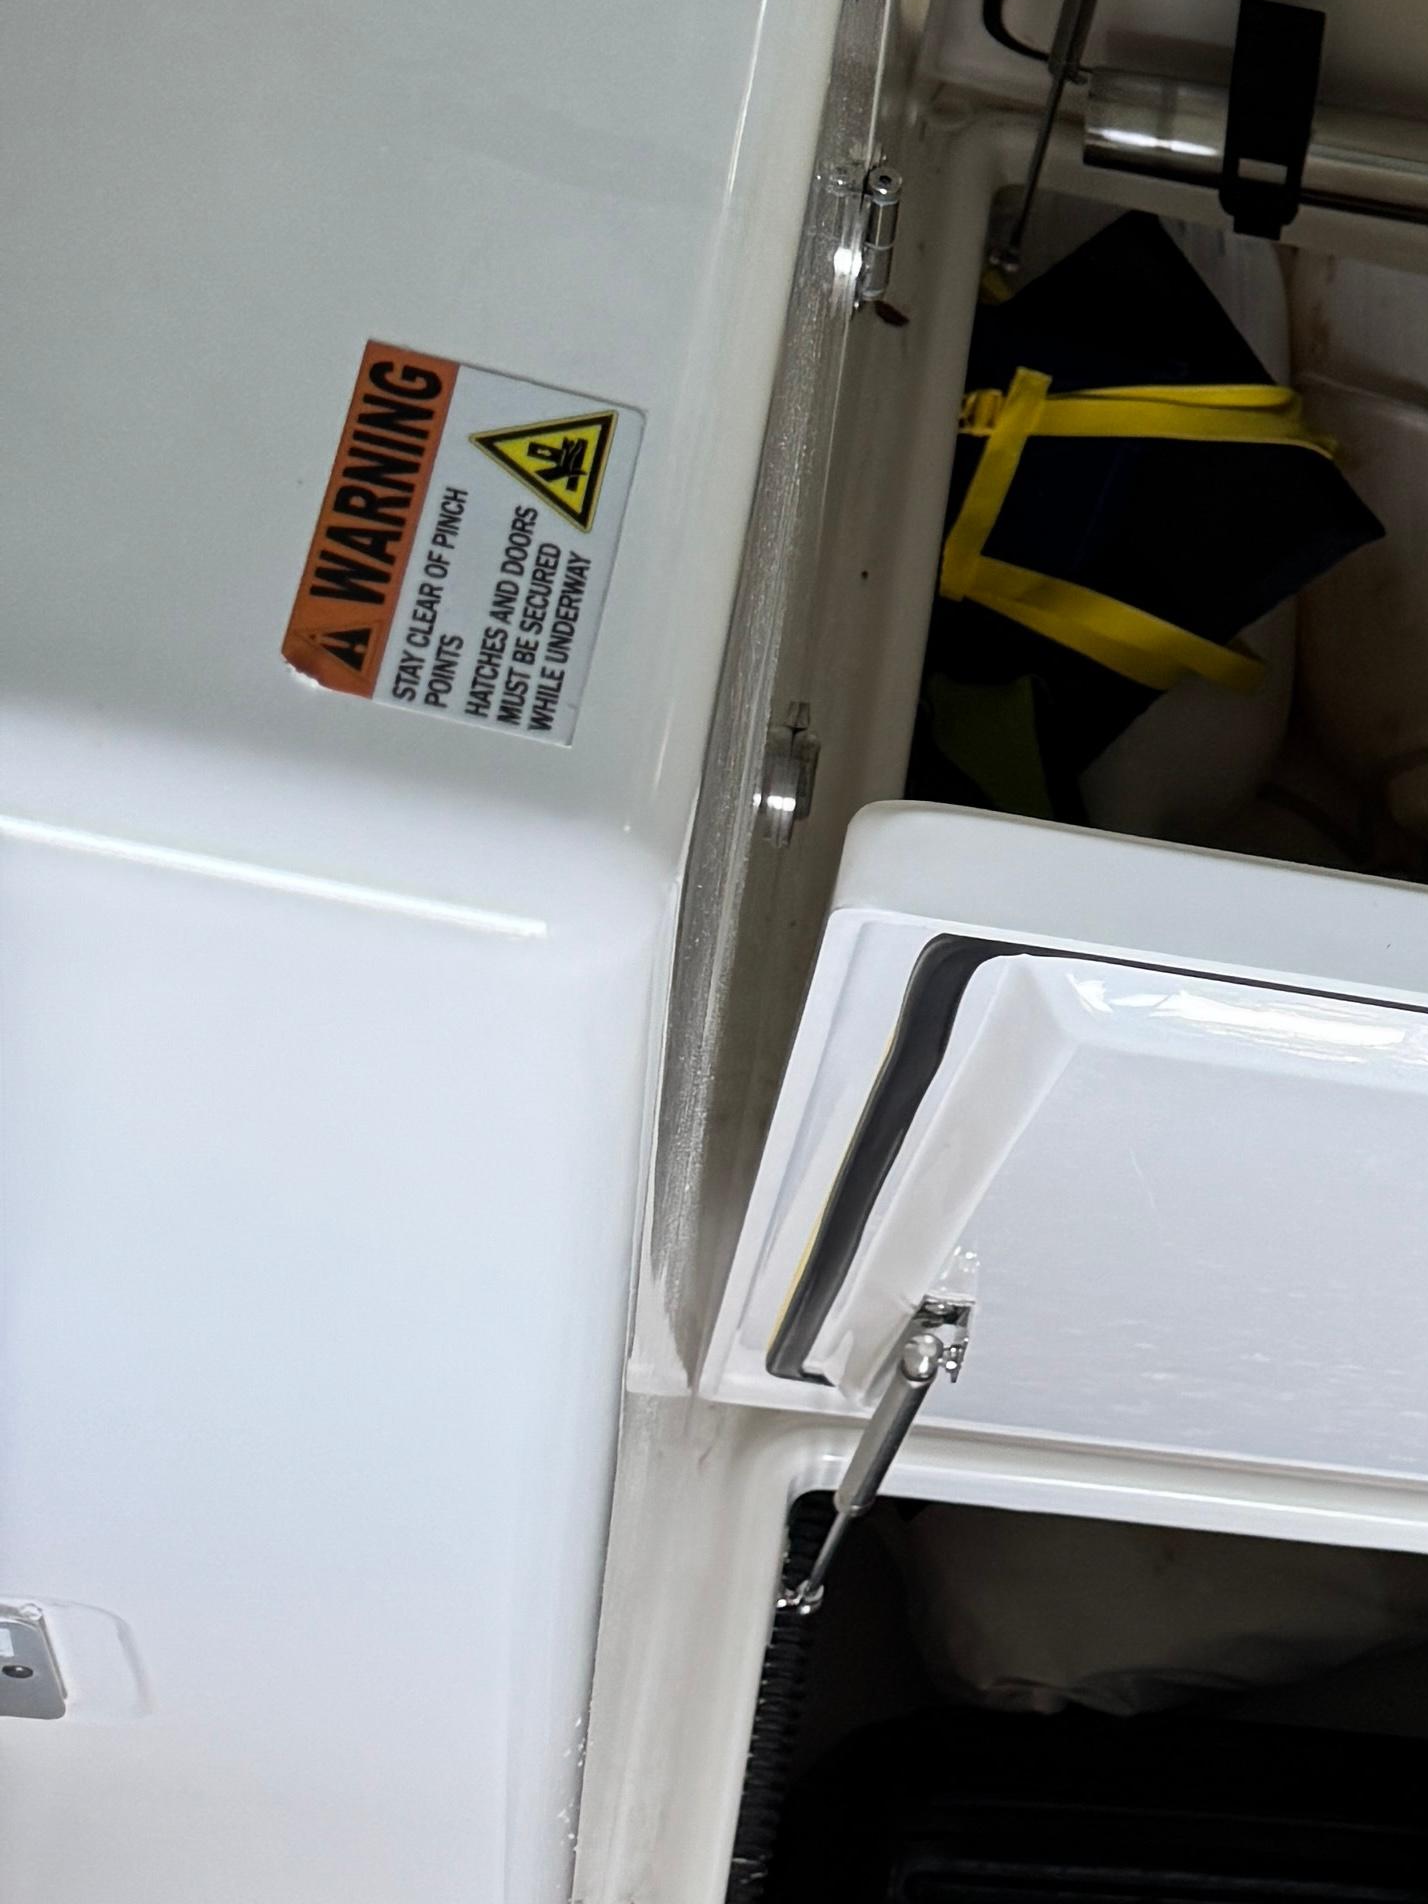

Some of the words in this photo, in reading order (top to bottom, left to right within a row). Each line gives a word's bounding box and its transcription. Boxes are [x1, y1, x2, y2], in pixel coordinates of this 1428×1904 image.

[309, 360, 442, 607] WARNING
[431, 487, 468, 549] PINCH
[500, 505, 538, 577] DOORS
[424, 550, 450, 579] OF
[519, 543, 561, 635] SECURED
[406, 582, 444, 648] CLEAR
[489, 580, 519, 625] AND
[544, 550, 592, 664] UNDERWAY
[392, 650, 426, 701] STAY
[424, 634, 464, 708] POINTS
[464, 626, 508, 717] HATCHES
[512, 637, 539, 665] BE
[496, 666, 531, 725] MUST
[527, 666, 565, 730] WHILE
